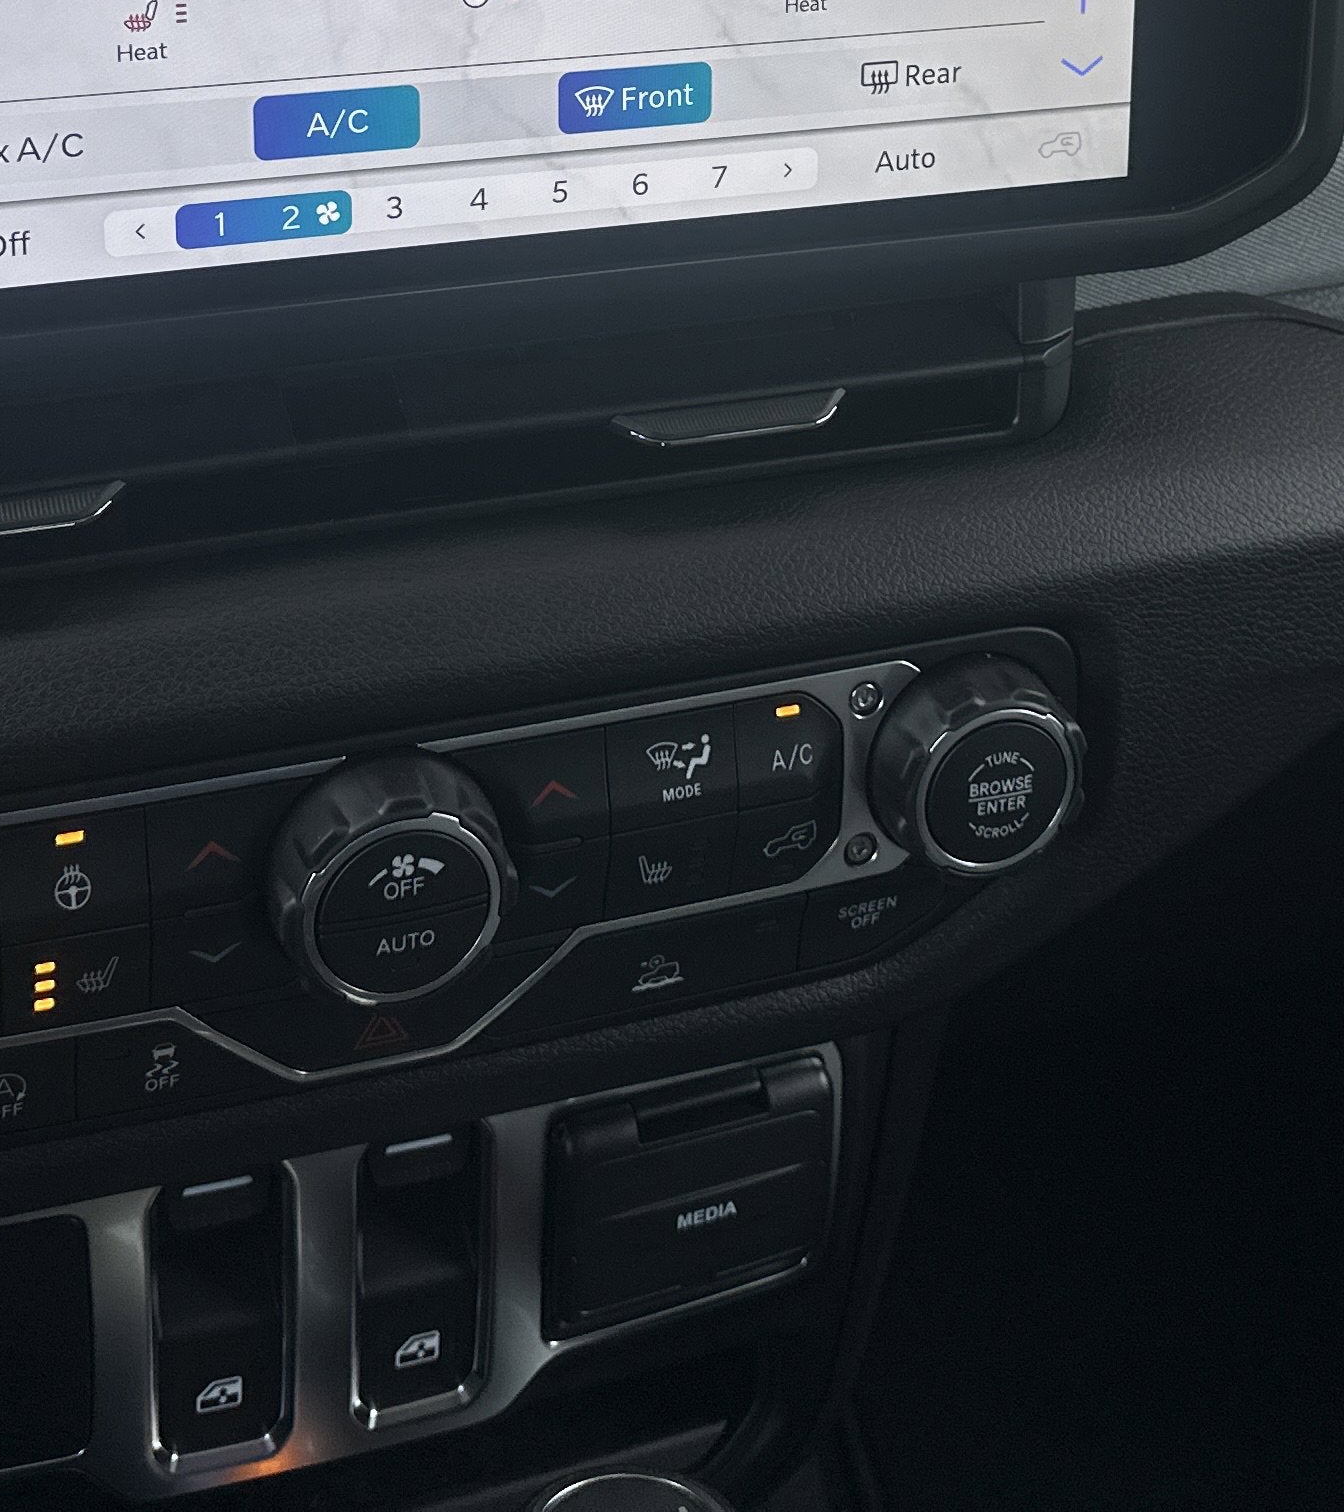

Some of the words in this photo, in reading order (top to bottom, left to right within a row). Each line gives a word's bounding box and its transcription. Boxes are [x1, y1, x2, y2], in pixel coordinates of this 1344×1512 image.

[117, 42, 168, 63] Heat
[905, 62, 962, 87] Rear
[621, 83, 694, 111] Front
[307, 108, 369, 138] A/C
[16, 134, 84, 165] A/C
[875, 147, 936, 173] Auto
[215, 212, 226, 237] 1
[282, 207, 300, 231] 2
[387, 196, 403, 221] 3
[470, 188, 488, 212] 4
[552, 181, 568, 205] 5
[632, 174, 649, 197] 6
[712, 166, 728, 189] 7
[772, 743, 813, 770] A/C
[985, 752, 1020, 768] TUNE
[662, 782, 702, 801] MODE
[969, 774, 1033, 797] BROWSE
[976, 794, 1027, 816] ENTER
[974, 817, 1025, 839] SCROLL
[383, 876, 424, 900] OFF
[837, 895, 898, 920] SCREEN
[851, 911, 881, 928] OFF
[376, 929, 435, 955] AUTO
[145, 1073, 180, 1092] OFF
[676, 1201, 737, 1229] MEDIA
